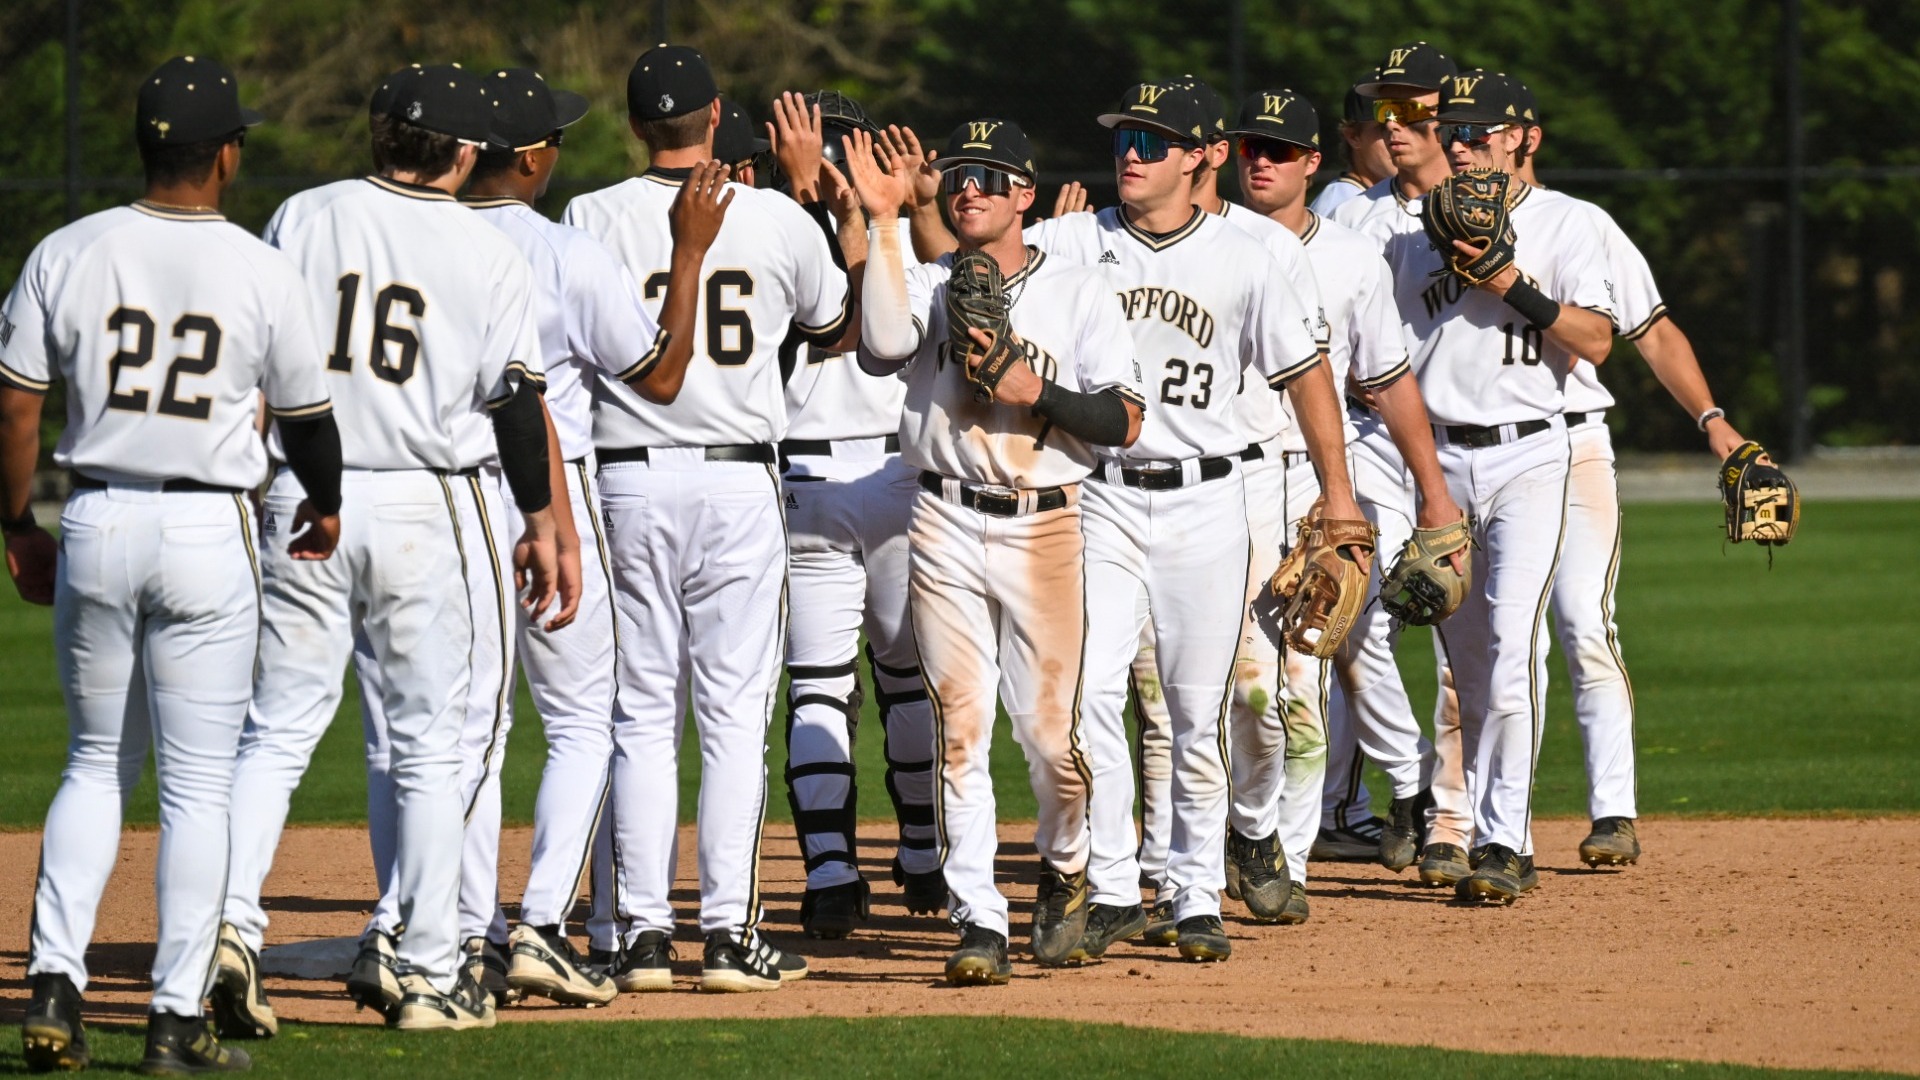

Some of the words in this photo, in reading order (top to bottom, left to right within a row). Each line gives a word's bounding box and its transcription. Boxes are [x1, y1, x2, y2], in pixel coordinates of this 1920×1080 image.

[1388, 48, 1412, 68] W
[1139, 84, 1167, 105] W
[1454, 76, 1479, 96] W
[1263, 95, 1290, 115] W
[967, 121, 998, 141] W
[1476, 183, 1488, 192] W
[1474, 250, 1504, 275] Wilson
[324, 269, 427, 387] 16
[1116, 286, 1215, 350] FFORD
[1502, 321, 1543, 367] 10
[104, 303, 224, 423] 22
[988, 345, 1010, 375] Wilson
[1160, 357, 1214, 410] 23
[1330, 526, 1368, 537] Wilson
[1330, 616, 1347, 645] A2000
